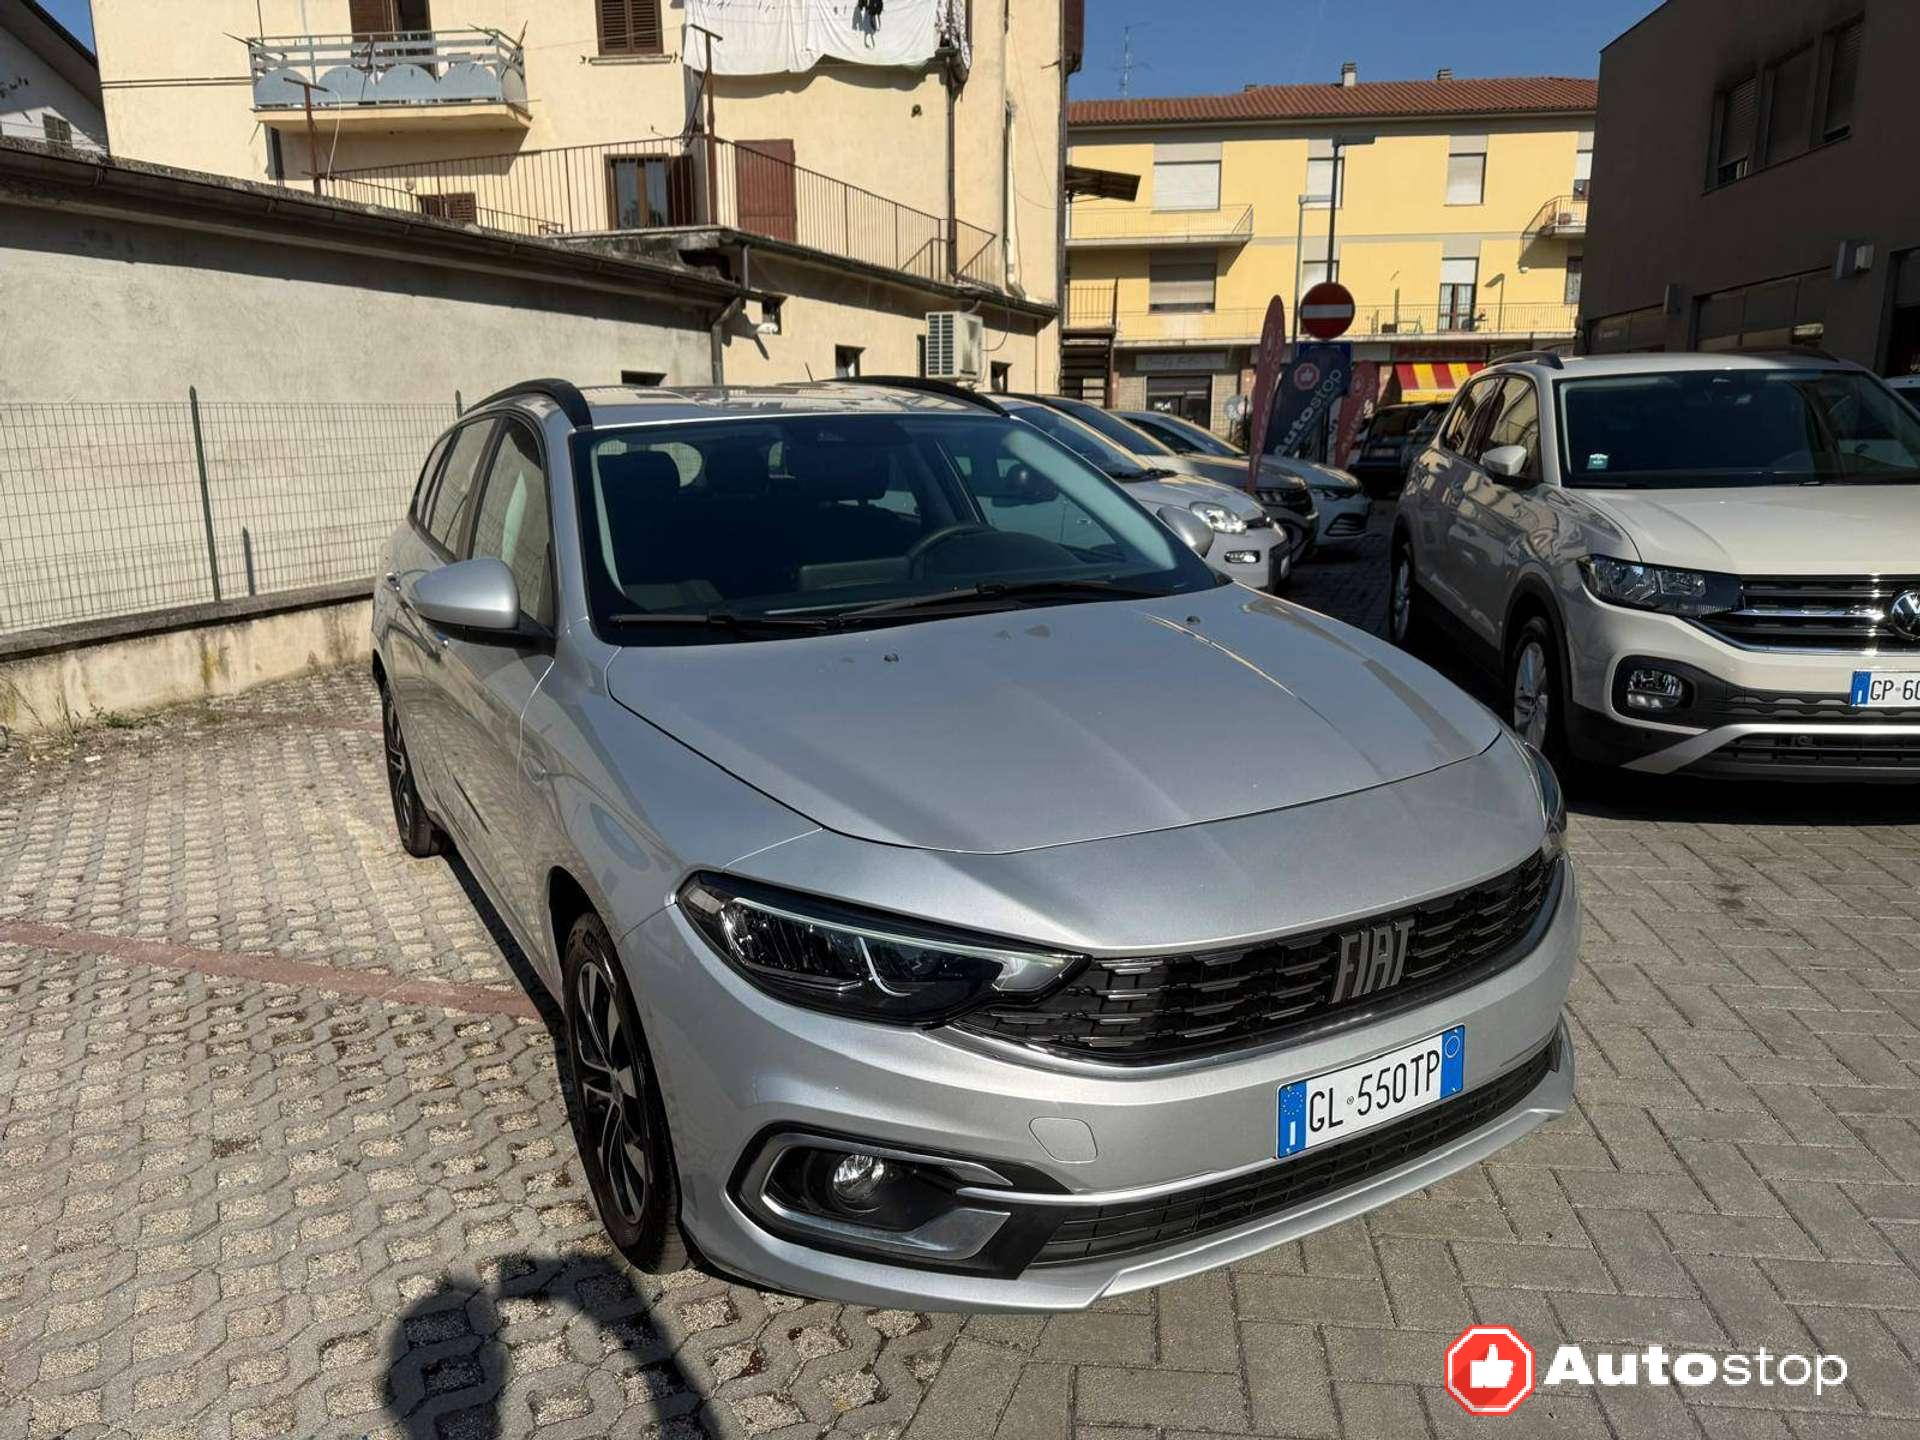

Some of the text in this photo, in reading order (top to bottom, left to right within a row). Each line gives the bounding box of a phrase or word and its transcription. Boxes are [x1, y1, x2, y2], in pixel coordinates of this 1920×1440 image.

[1871, 680, 1894, 701] GP
[1330, 918, 1414, 1003] FIAT
[1309, 1050, 1440, 1133] GL 550TP
